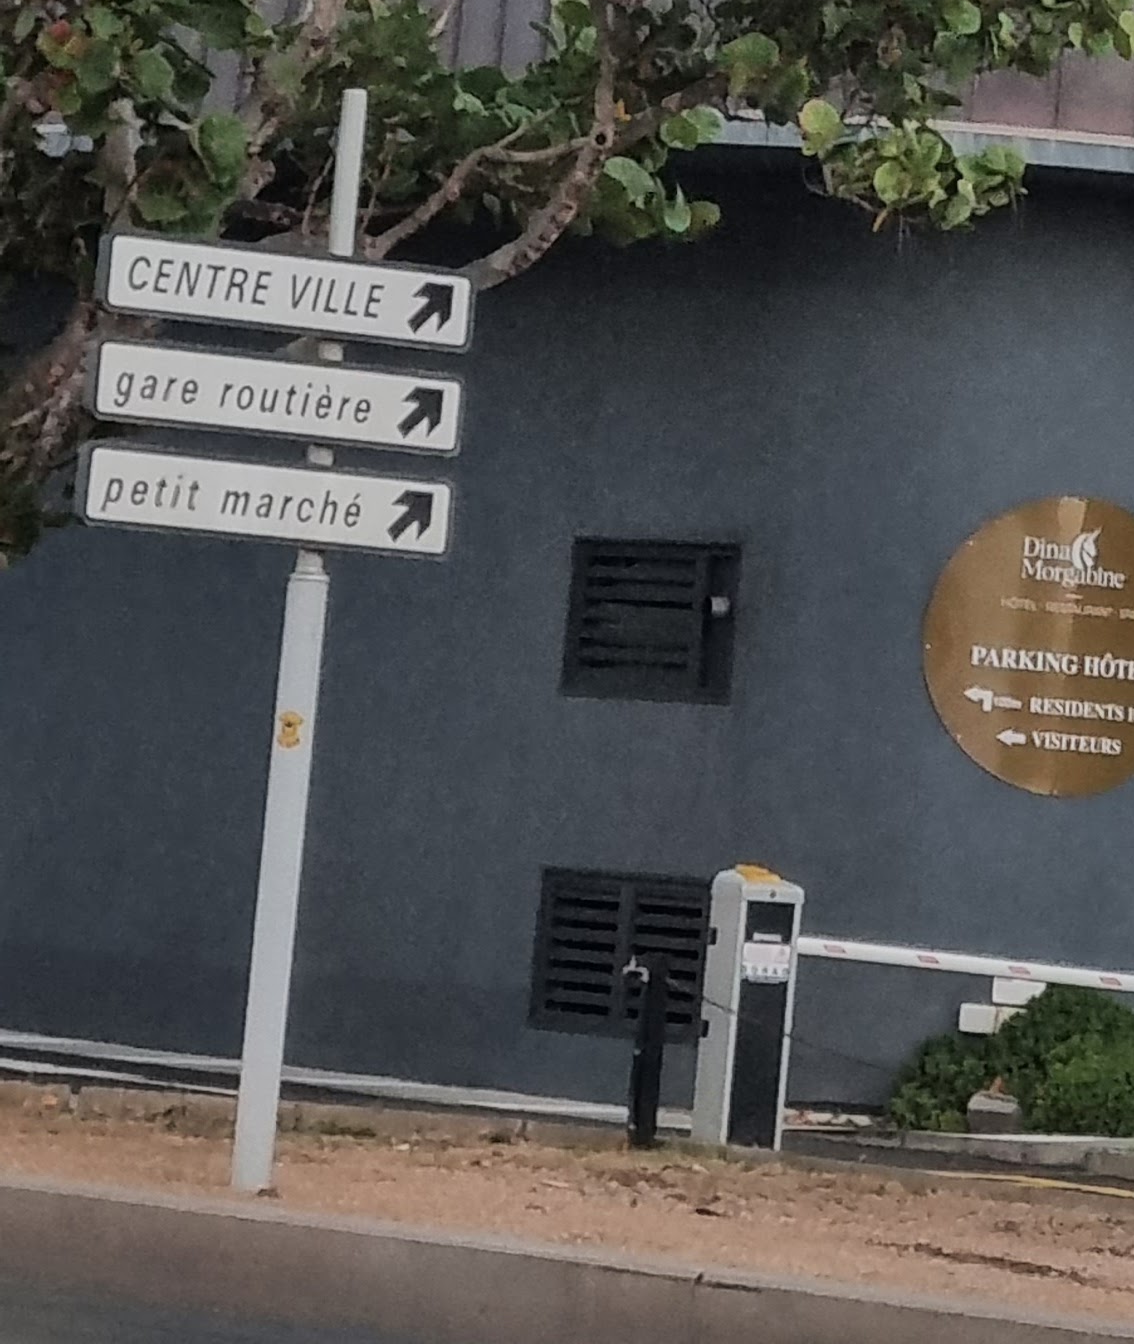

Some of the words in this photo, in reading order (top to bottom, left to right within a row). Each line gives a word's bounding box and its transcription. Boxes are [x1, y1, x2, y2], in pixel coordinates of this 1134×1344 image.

[127, 255, 272, 306] CENTRE
[291, 273, 385, 318] VILLE
[113, 370, 199, 408] gare
[219, 381, 372, 423] routière
[101, 474, 200, 512] petit
[220, 481, 362, 527] marché
[1023, 535, 1071, 561] Dina
[1021, 557, 1126, 589] Morgabine
[970, 644, 1080, 676] PARKING
[1029, 696, 1125, 722] RESIDENTS
[1031, 730, 1123, 756] VISITEURS
